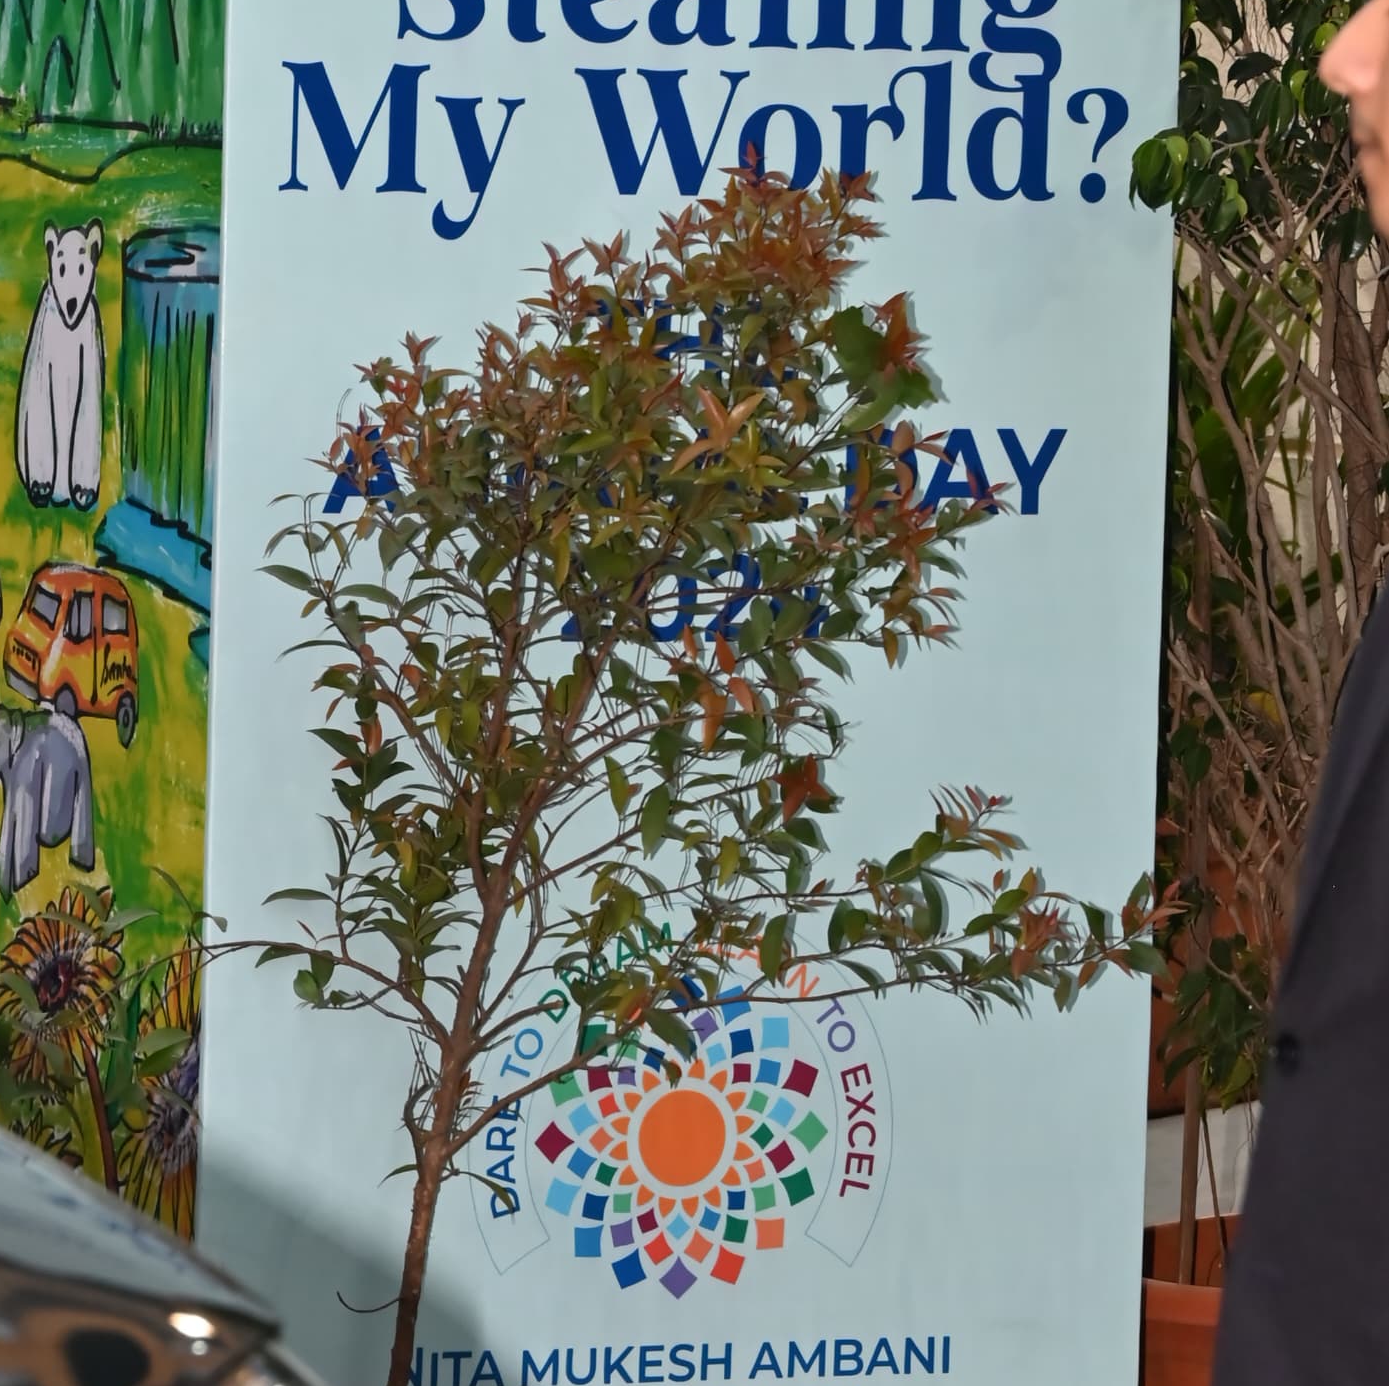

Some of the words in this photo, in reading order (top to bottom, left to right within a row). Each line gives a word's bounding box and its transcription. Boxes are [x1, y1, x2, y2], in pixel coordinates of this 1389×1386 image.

[277, 60, 527, 240] My
[574, 60, 1131, 205] World?
[844, 427, 1068, 517] DAY
[500, 1027, 544, 1078] TO
[816, 996, 856, 1053] TO
[485, 1095, 522, 1219] DARE
[839, 1063, 877, 1198] EXCEL
[748, 1335, 952, 1380] AMBANI
